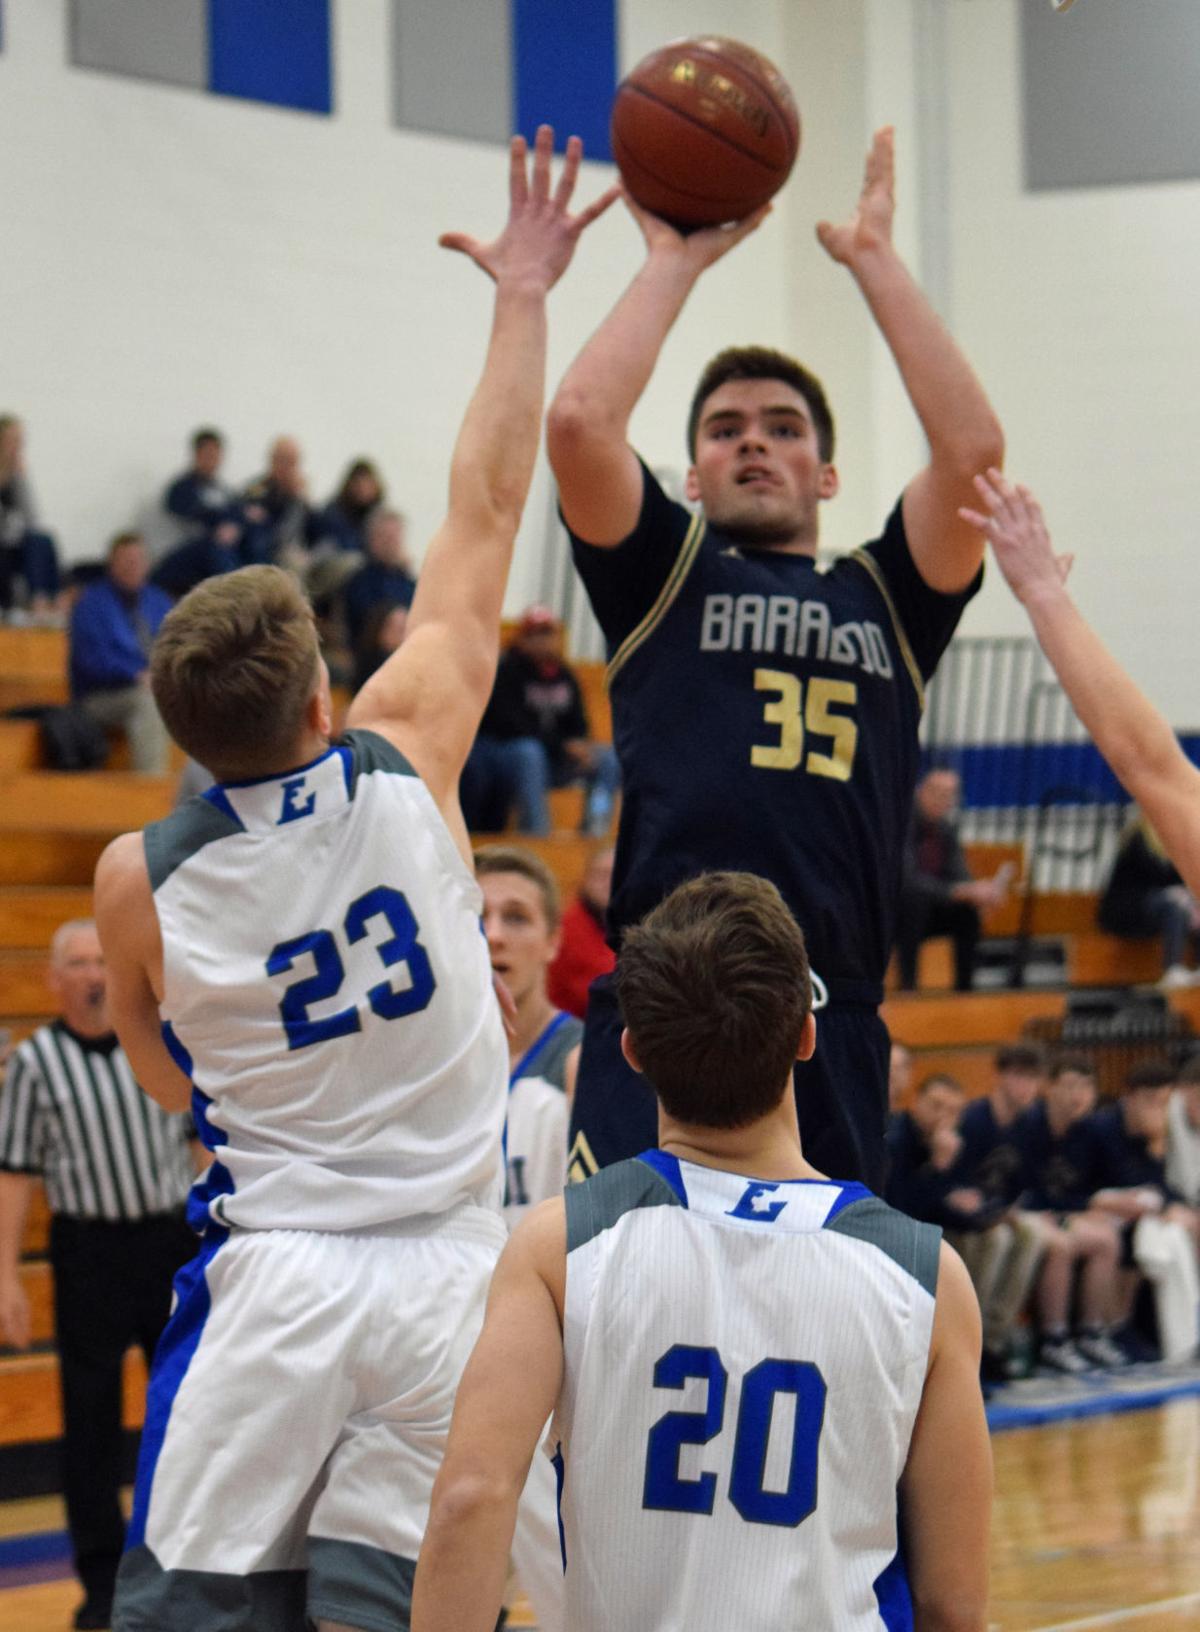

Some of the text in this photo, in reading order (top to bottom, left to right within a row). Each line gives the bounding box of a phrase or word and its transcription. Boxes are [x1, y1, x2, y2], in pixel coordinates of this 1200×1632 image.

[751, 667, 858, 782] 35
[276, 776, 317, 826] E
[265, 884, 437, 1051] 23
[723, 1181, 788, 1223] E
[641, 1343, 828, 1529] 20
